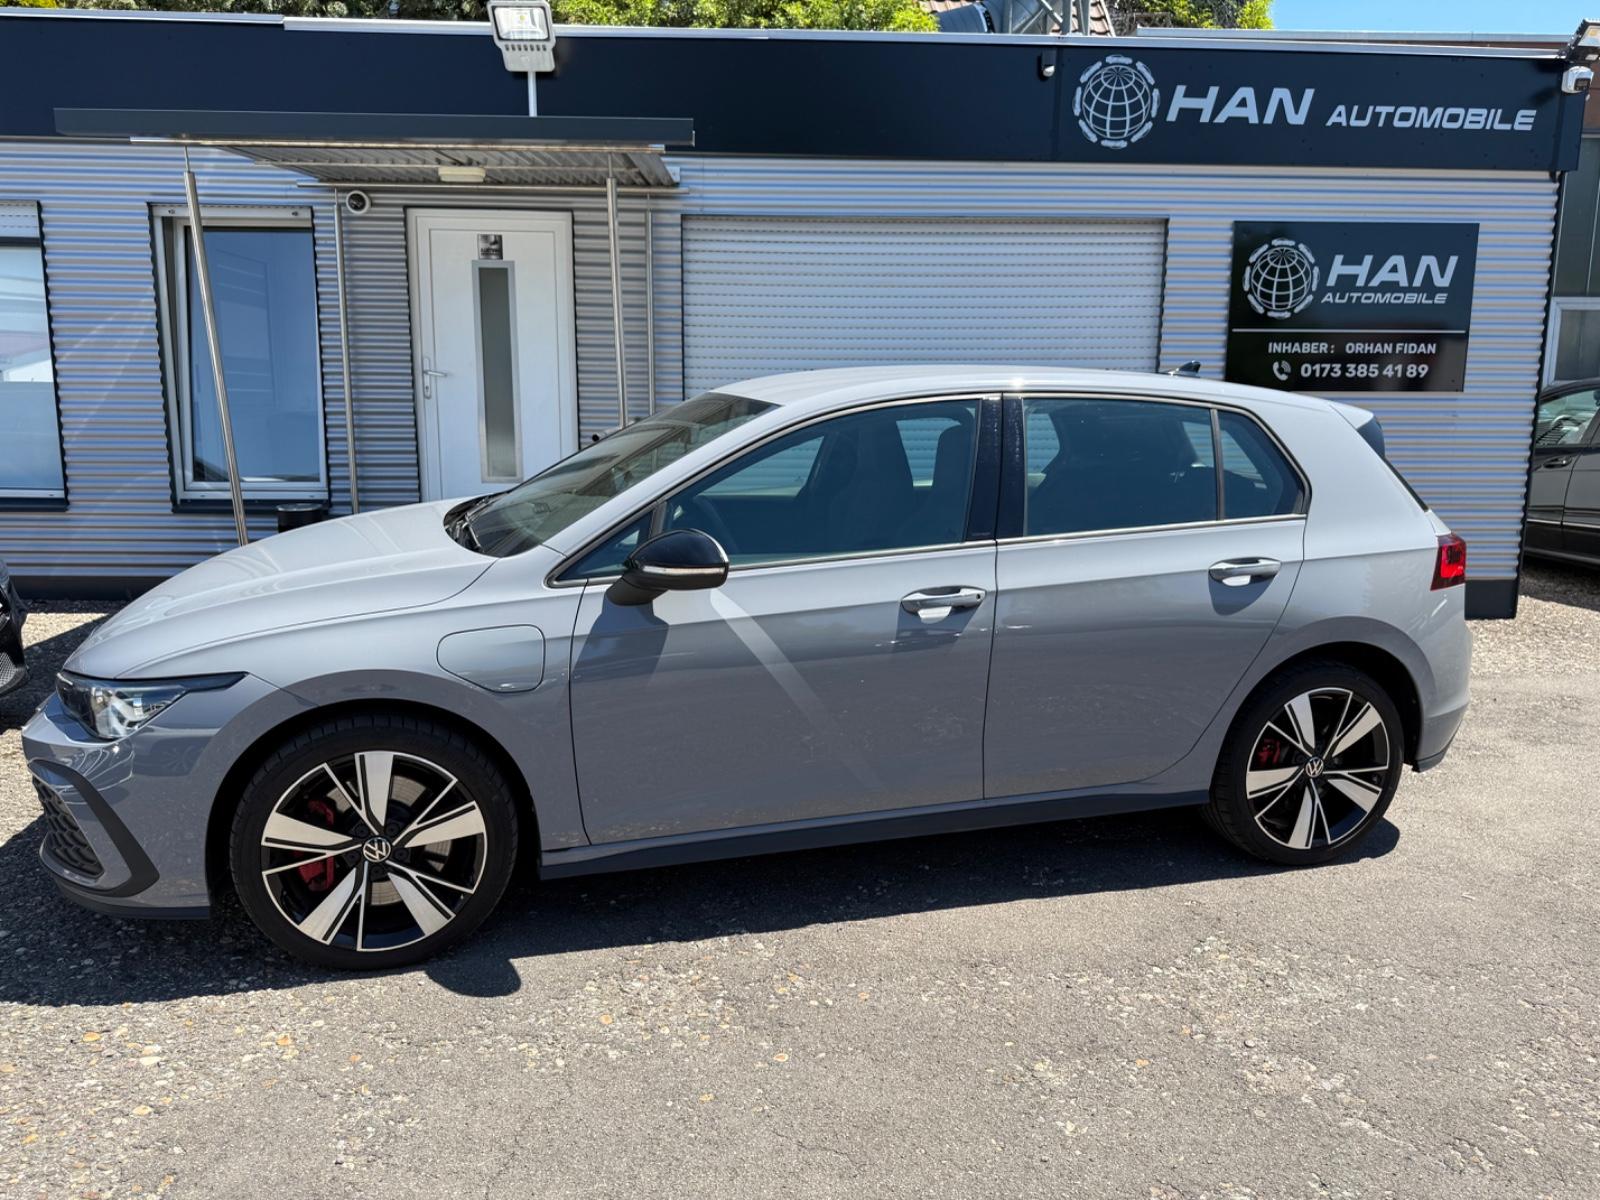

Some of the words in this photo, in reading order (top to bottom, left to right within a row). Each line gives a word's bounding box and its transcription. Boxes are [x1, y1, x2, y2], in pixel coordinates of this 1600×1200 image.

[1166, 85, 1314, 124] HAN
[1326, 105, 1537, 131] AUTOMOBILE
[1326, 254, 1459, 287] HAN
[1321, 292, 1448, 304] AUTOMOBILE
[1345, 343, 1393, 354] ORHAN
[1395, 343, 1437, 355] FIDAN
[1300, 363, 1342, 378] 0173
[1345, 363, 1379, 378] 385
